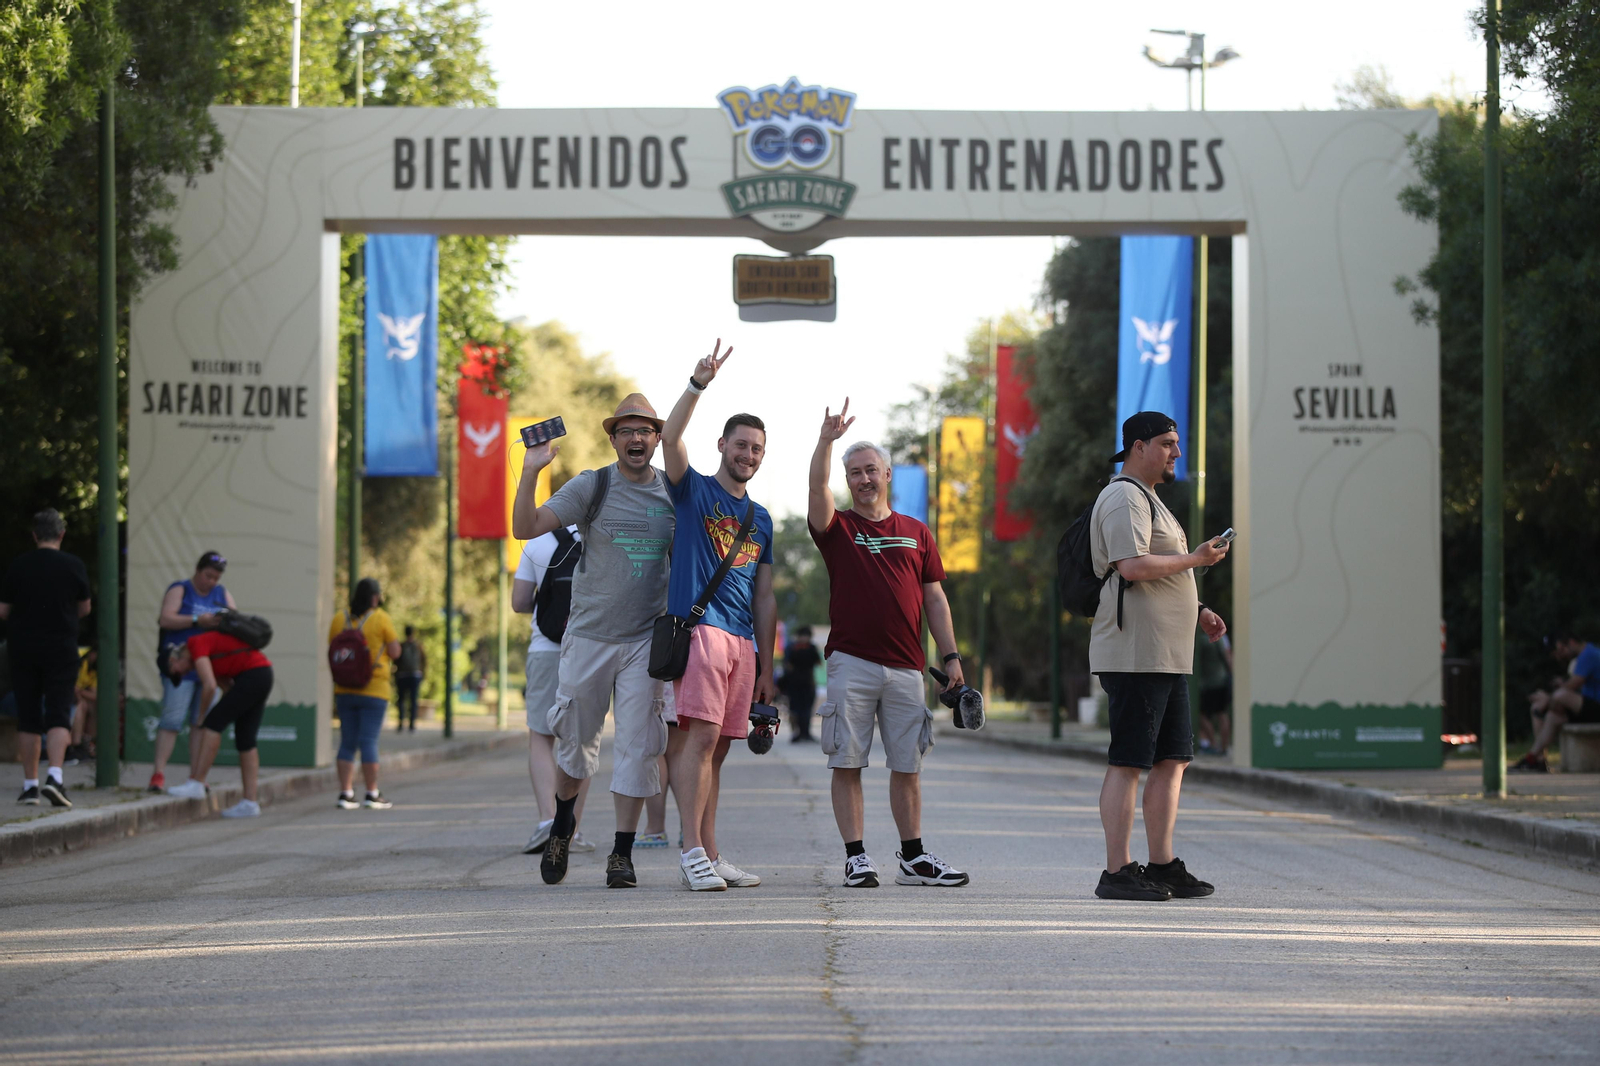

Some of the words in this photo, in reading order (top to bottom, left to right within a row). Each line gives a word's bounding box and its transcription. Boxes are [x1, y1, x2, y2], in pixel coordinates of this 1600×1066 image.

[751, 124, 827, 164] GO
[393, 135, 689, 190] BIENVENIDOS
[883, 138, 1225, 192] ENTRENADORES
[733, 179, 798, 209] SAFARI
[801, 180, 848, 209] ZONE
[191, 359, 243, 376] WELCOME
[246, 361, 262, 376] TO
[1327, 362, 1363, 378] SPAIN
[142, 381, 234, 416] SAFARI
[242, 384, 308, 419] ZONE
[1293, 386, 1397, 420] SEVILLA
[1288, 728, 1342, 741] NIANTIC
